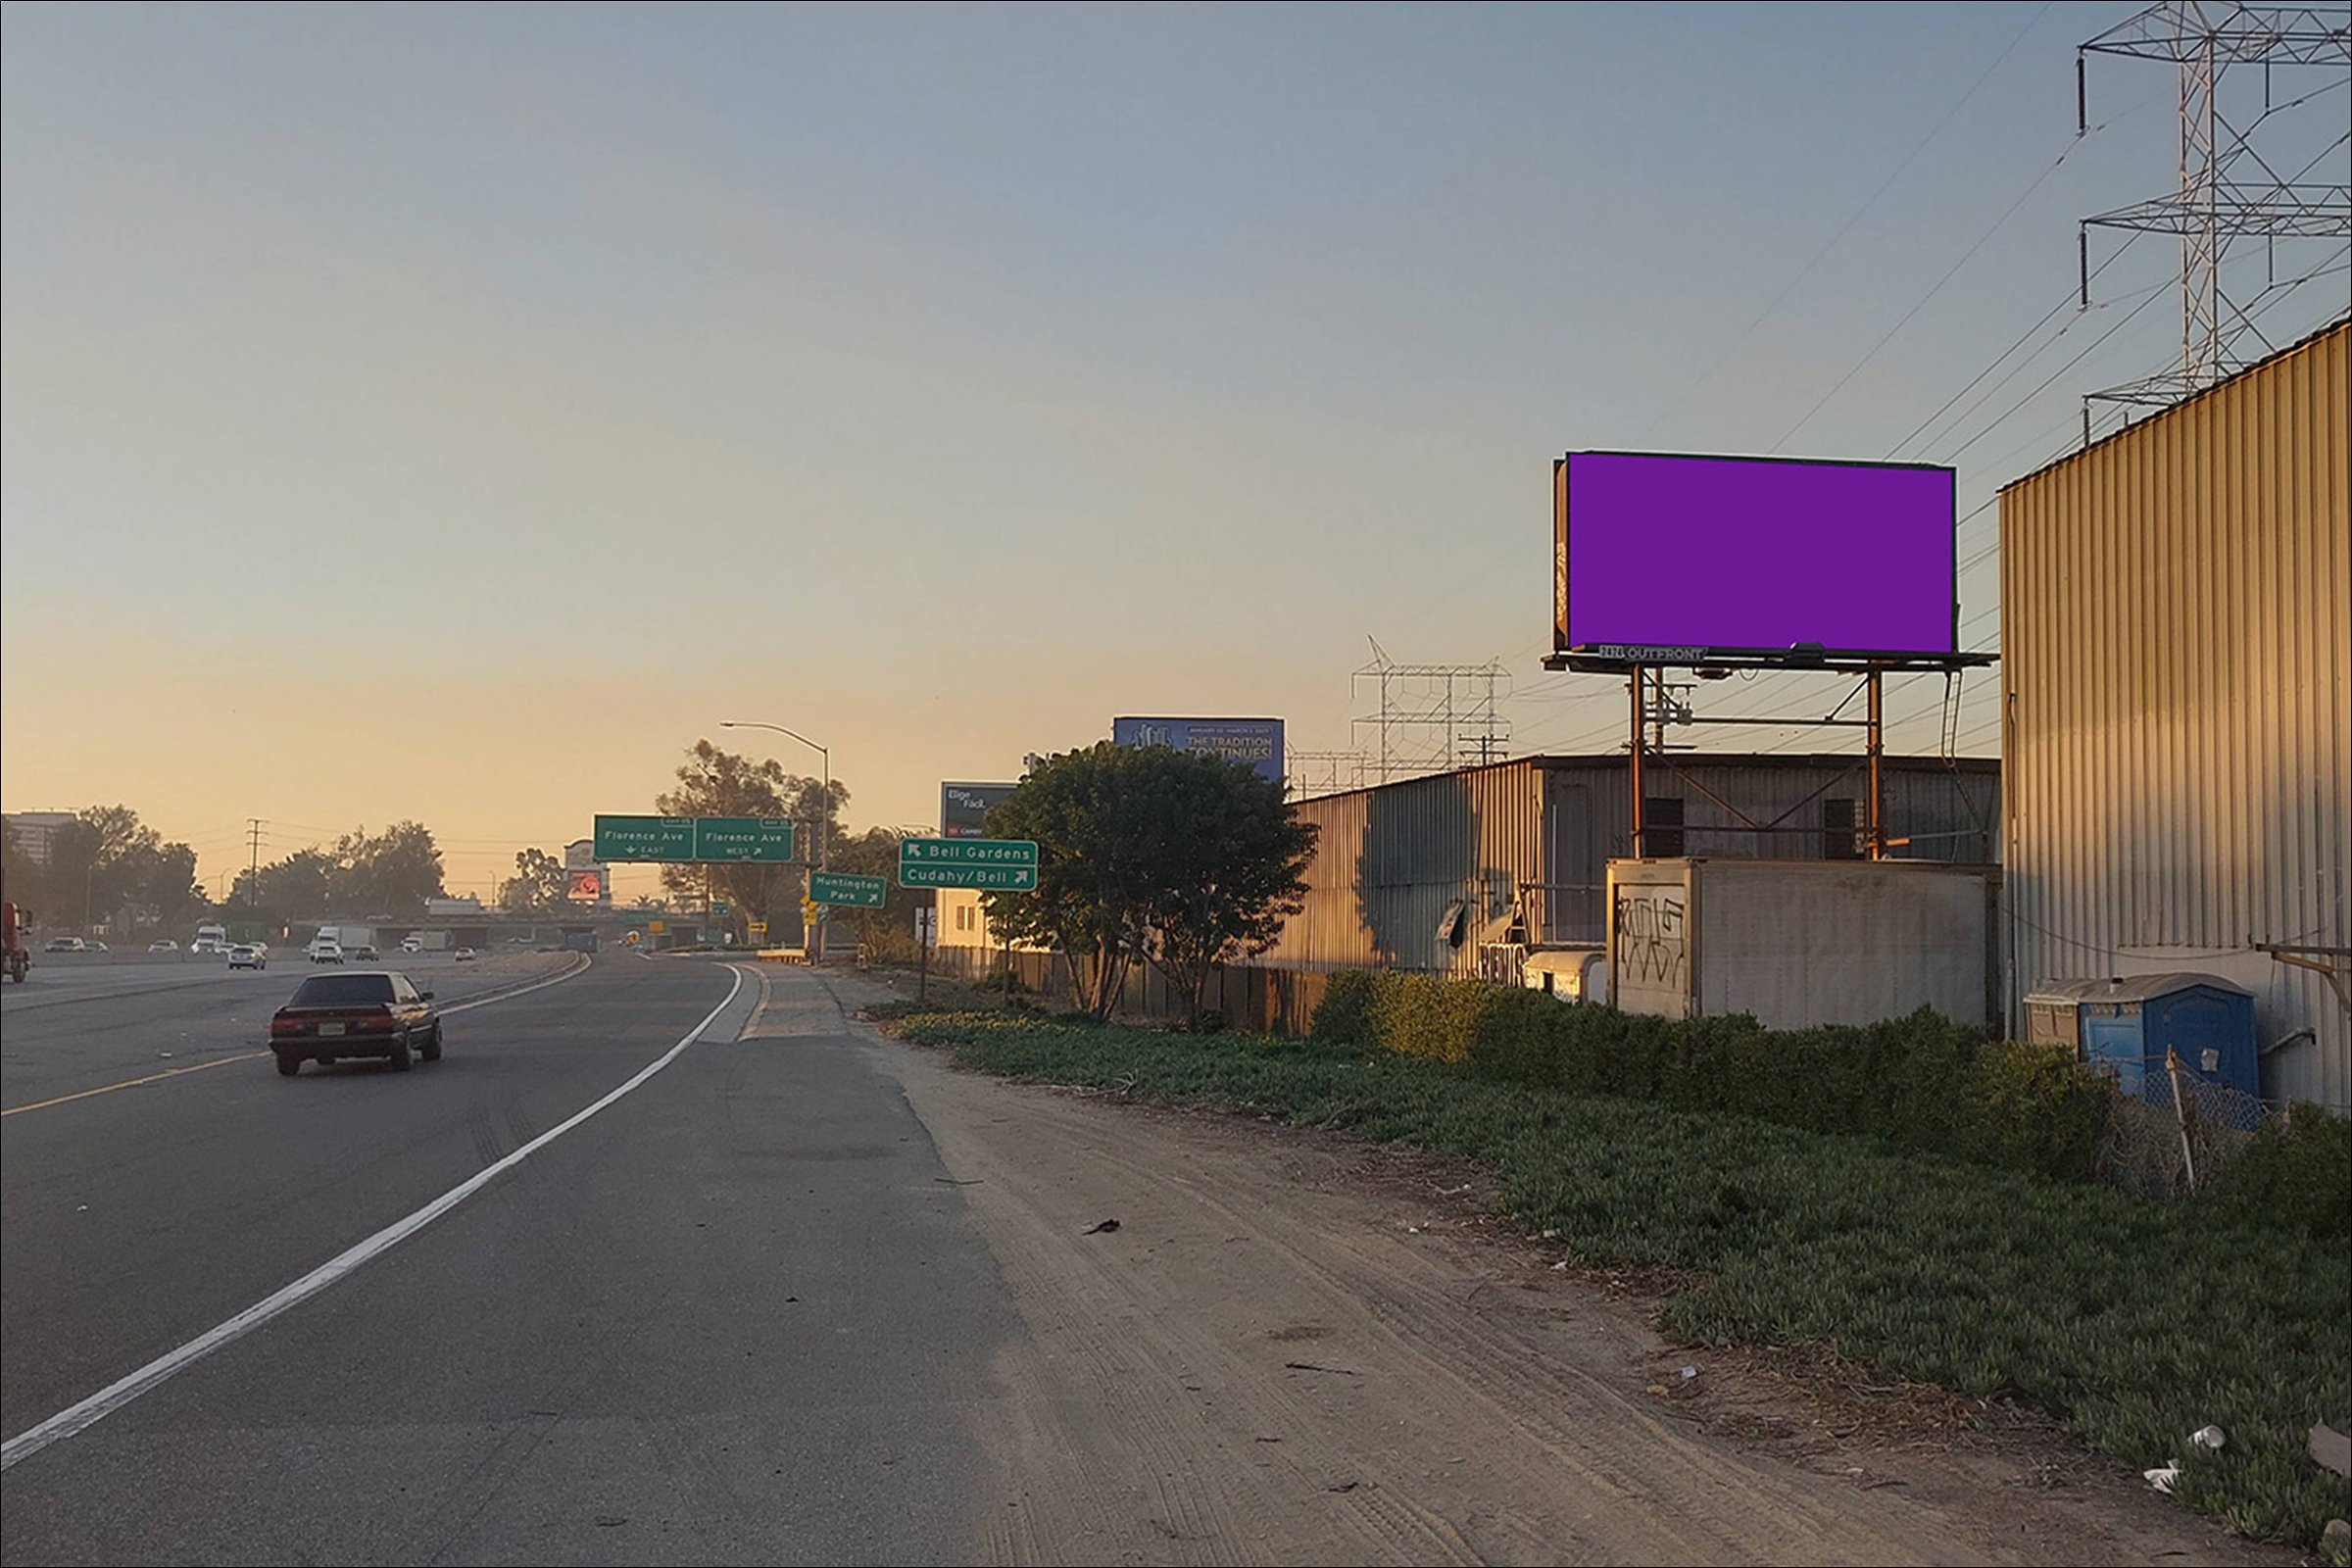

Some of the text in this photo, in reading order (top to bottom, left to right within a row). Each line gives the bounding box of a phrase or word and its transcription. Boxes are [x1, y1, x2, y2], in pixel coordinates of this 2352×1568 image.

[1627, 647, 1704, 660] OUTFRONT
[1187, 737, 1273, 746] THE TRADITION
[605, 831, 684, 841] Florence Ave
[706, 833, 783, 843] Florence Ave
[930, 845, 1031, 859] Bell Gardens
[907, 869, 1007, 885] Cudahy/Bell
[815, 876, 880, 890] Huntington
[830, 891, 856, 901] Park
